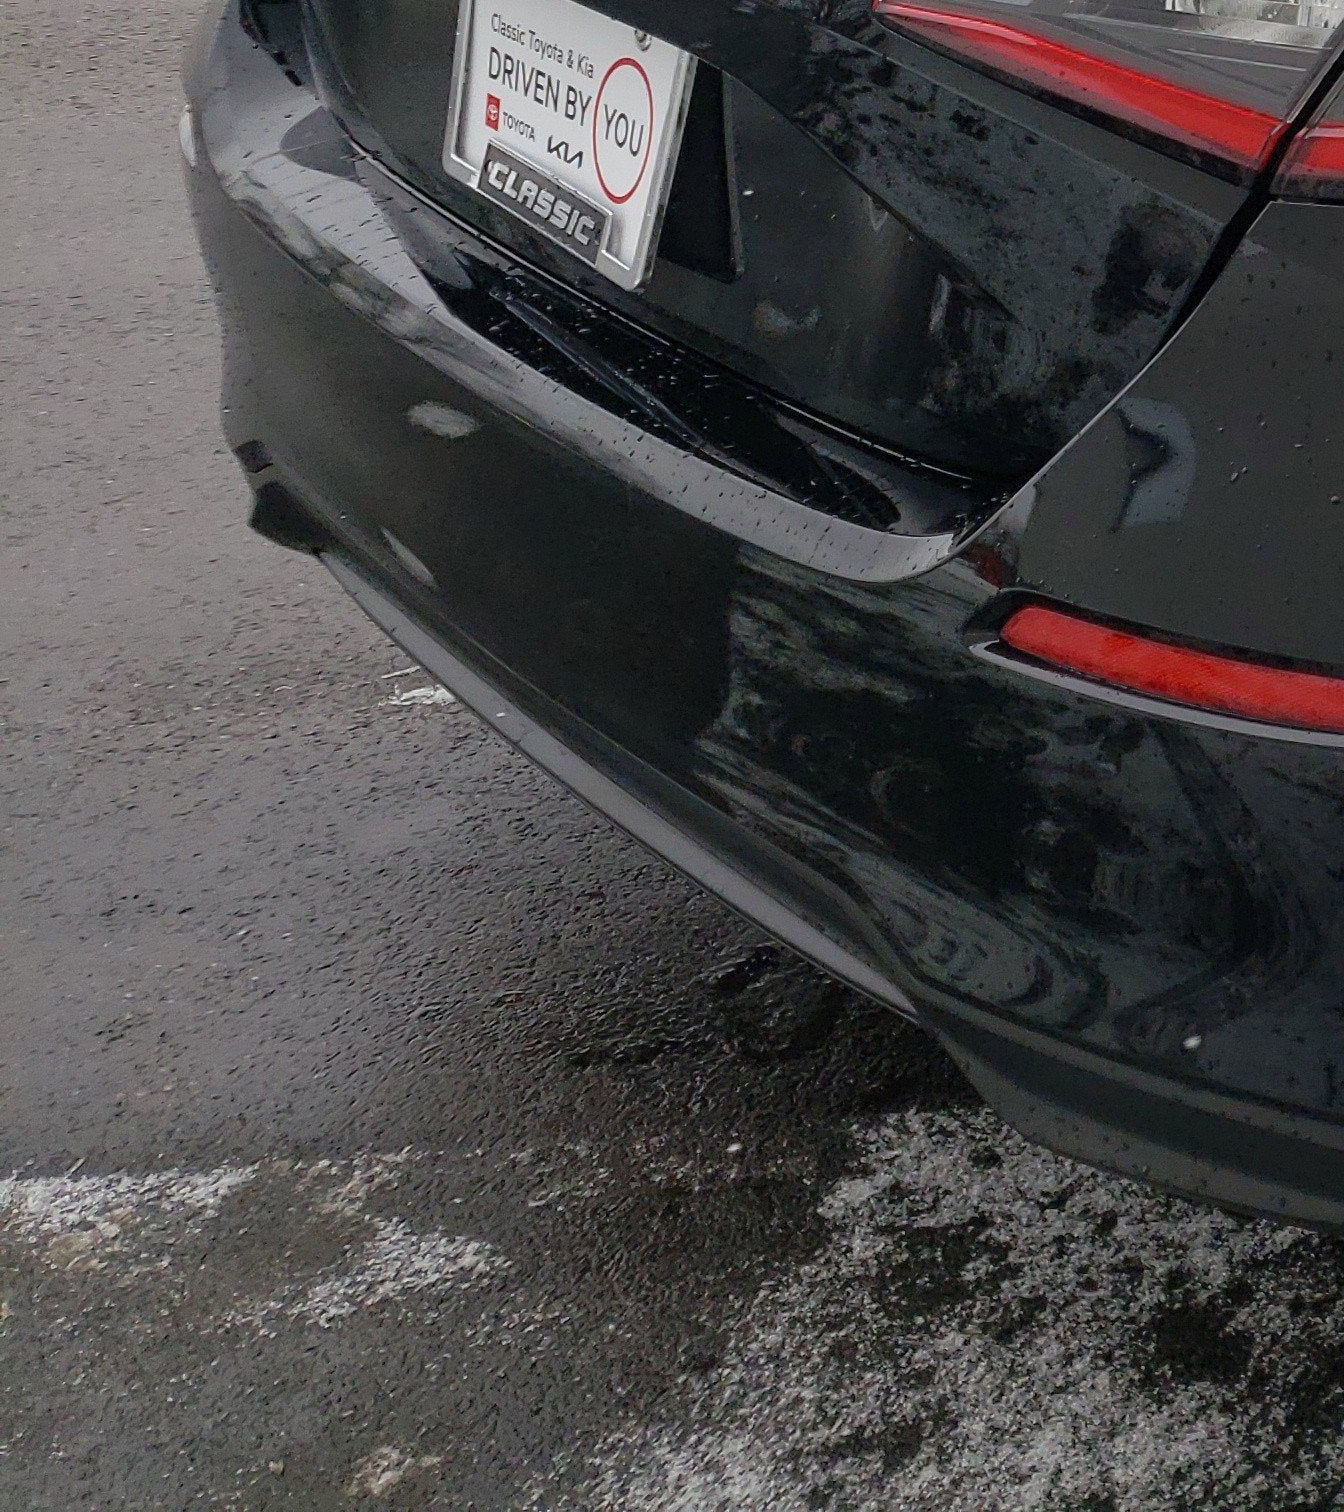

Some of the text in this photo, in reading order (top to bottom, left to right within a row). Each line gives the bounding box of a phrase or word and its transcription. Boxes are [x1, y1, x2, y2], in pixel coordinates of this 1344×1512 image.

[490, 12, 595, 79] Classic Toyota & Kia
[488, 46, 645, 158] DRIVEN BY YOU
[502, 111, 537, 143] TOYOTA
[487, 160, 597, 247] CLASSIC
